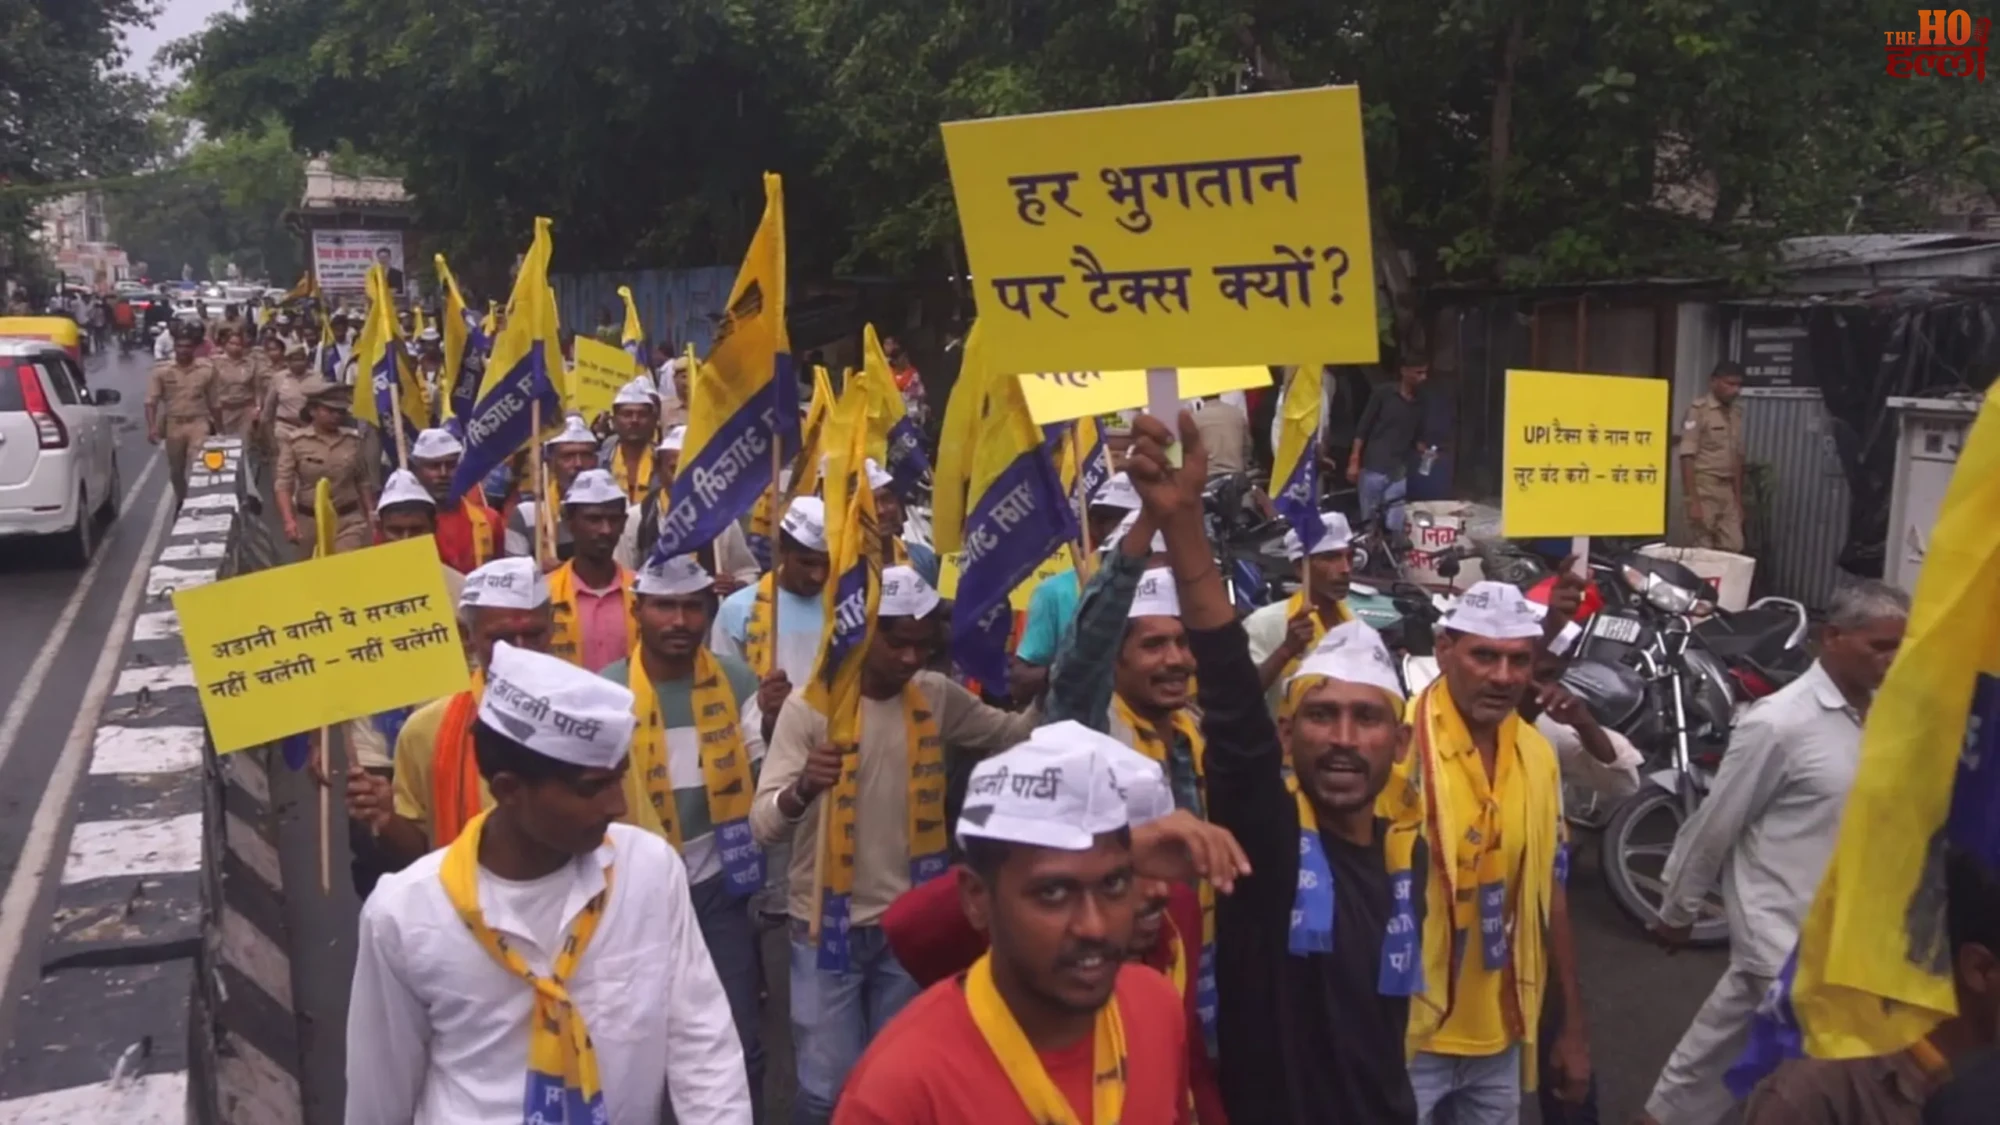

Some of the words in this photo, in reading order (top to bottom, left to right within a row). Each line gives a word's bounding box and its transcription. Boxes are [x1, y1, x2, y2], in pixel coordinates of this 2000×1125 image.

[1008, 172, 1082, 226] हर
[1100, 155, 1301, 234] भुगतान
[992, 275, 1069, 319] पर
[1070, 245, 1192, 314] टैक्स
[1212, 243, 1350, 310] क्यों?
[1523, 425, 1550, 444] UPI
[1552, 417, 1582, 444] टैक्स
[1587, 423, 1599, 445] के
[1604, 429, 1629, 446] नाम
[1634, 430, 1653, 446] पर
[1513, 467, 1535, 492] लूट
[1539, 463, 1559, 484] बंद
[1565, 461, 1590, 484] करो
[1611, 464, 1629, 484] बंद
[1634, 463, 1657, 486] करो
[212, 625, 277, 661] अडानी
[283, 611, 333, 642] वाली
[339, 606, 357, 628] ये
[364, 593, 432, 623] सरकार
[208, 670, 248, 699] नहीं
[256, 653, 316, 686] चलेंगी
[347, 637, 384, 664] नहीं
[392, 622, 450, 653] चलेंगी
[553, 710, 604, 742] पार्टी
[1011, 767, 1063, 801] पार्टी
